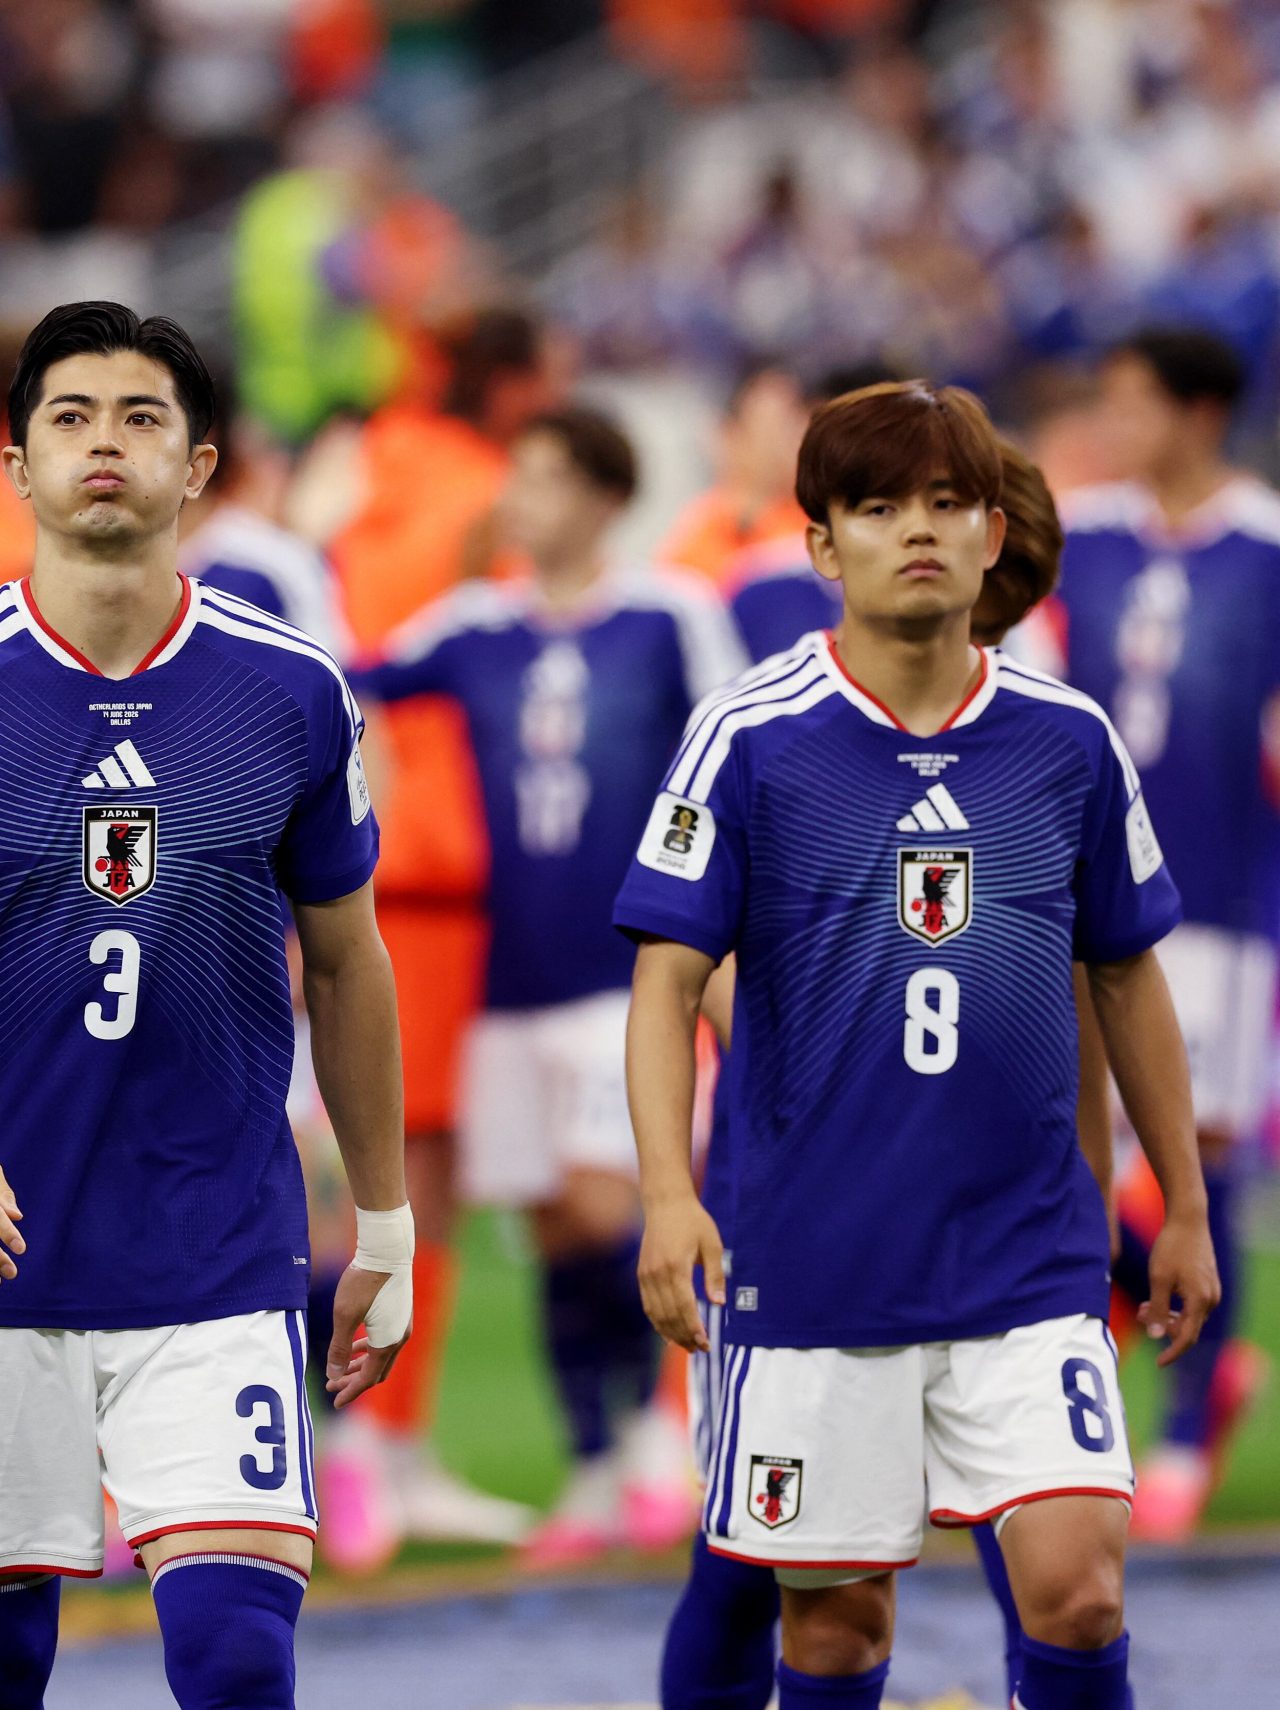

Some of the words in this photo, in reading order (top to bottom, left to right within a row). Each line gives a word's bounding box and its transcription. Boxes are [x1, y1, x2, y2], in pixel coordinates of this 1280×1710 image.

[100, 810, 139, 818] JAPAN
[915, 852, 955, 861] JAPAN
[102, 873, 136, 887] JFA
[83, 929, 141, 1040] 3
[903, 967, 960, 1075] 8
[235, 1384, 288, 1491] 3
[1060, 1357, 1116, 1453] 8
